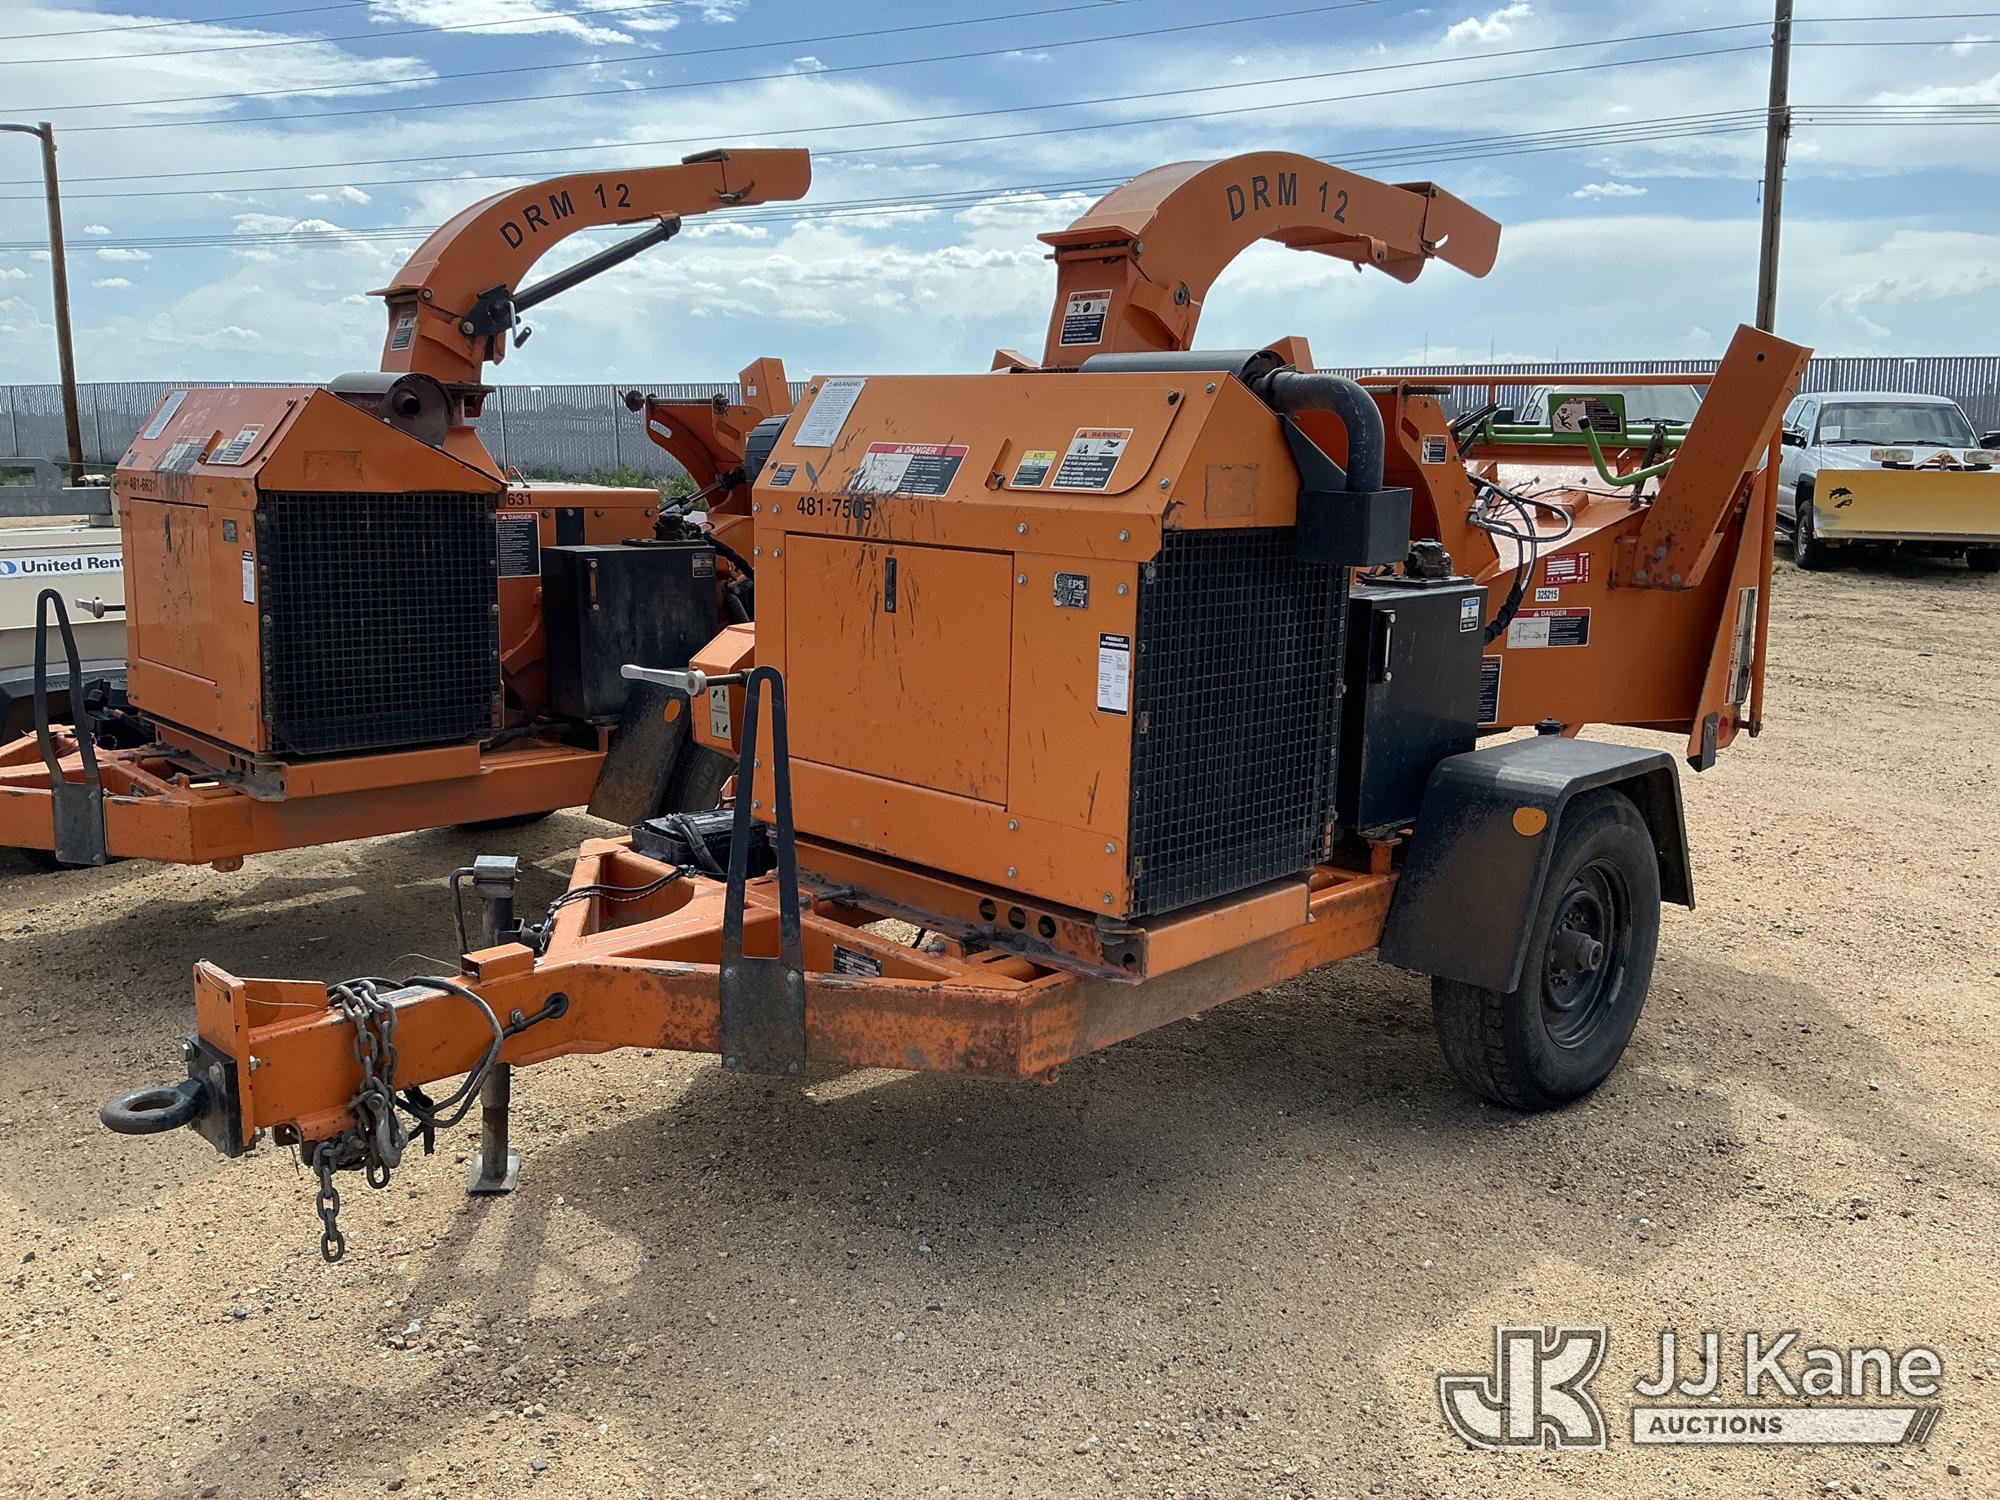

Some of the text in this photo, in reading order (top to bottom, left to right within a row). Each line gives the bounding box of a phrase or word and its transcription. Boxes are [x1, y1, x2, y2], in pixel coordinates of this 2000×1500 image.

[1226, 172, 1349, 224] DRM 12
[499, 183, 631, 250] DRM 12
[904, 446, 938, 455] DANGER
[797, 496, 873, 520] 481-7505
[22, 557, 123, 573] United Ren
[1068, 579, 1085, 590] EPS
[1537, 590, 1558, 600] 325215
